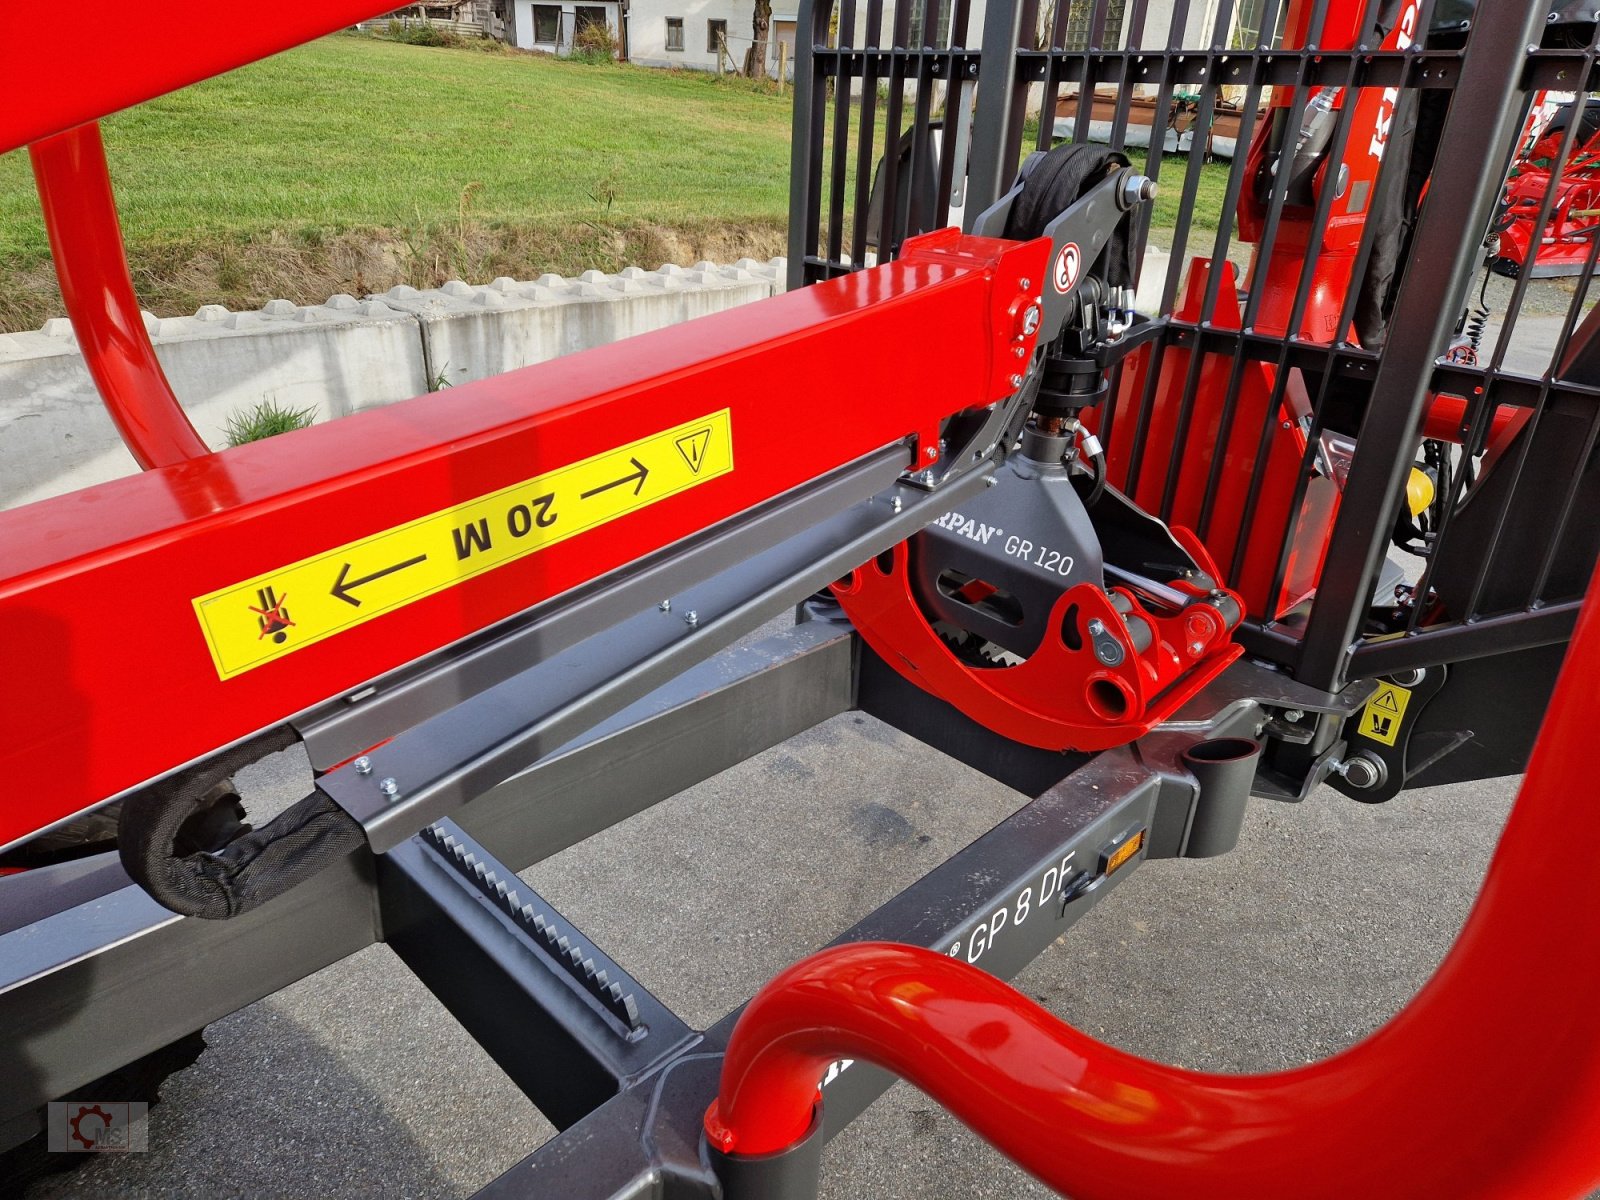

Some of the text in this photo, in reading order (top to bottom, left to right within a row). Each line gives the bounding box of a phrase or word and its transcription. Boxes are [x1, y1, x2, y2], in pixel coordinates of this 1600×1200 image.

[451, 491, 558, 561] 20 M
[1004, 535, 1033, 561] GR
[1034, 546, 1074, 576] 120
[967, 850, 1076, 963] GP 8 DF
